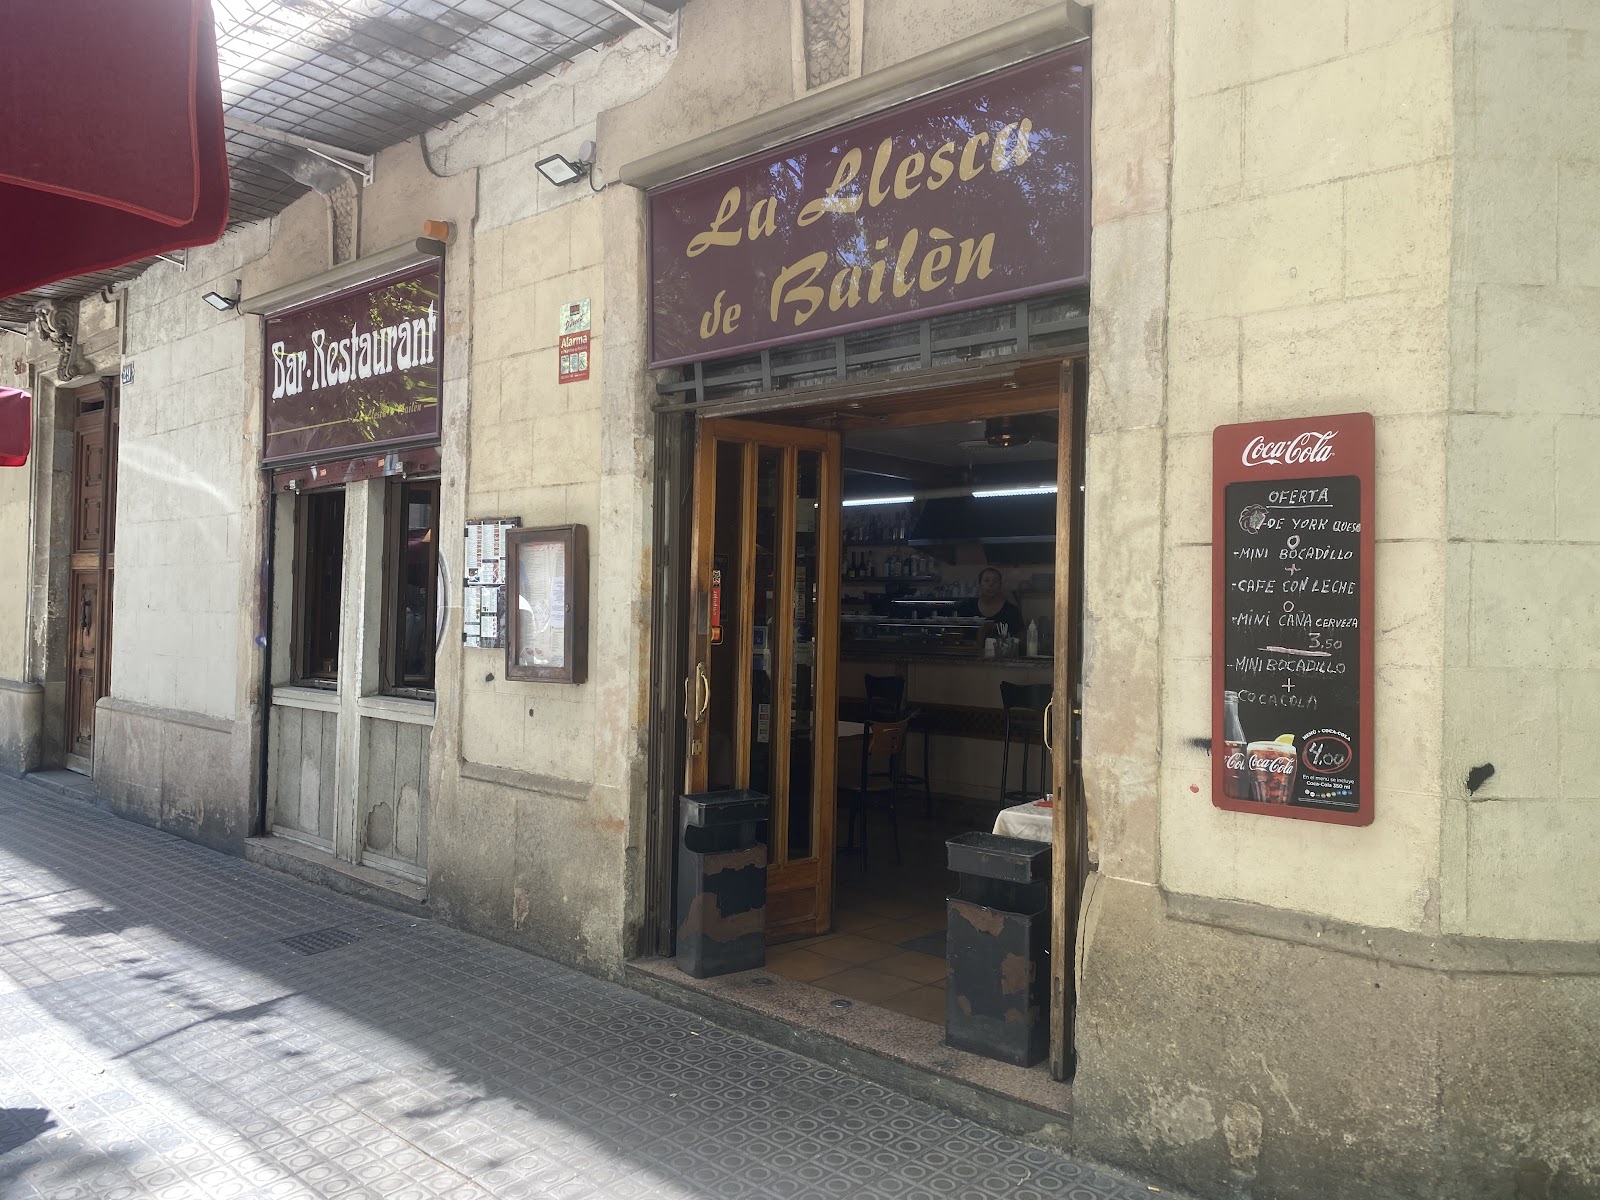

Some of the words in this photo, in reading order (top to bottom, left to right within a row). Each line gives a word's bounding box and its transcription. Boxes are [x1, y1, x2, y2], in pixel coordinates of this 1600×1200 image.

[686, 186, 779, 258] La
[797, 117, 1034, 227] Llesca
[699, 290, 742, 340] de
[770, 228, 996, 326] Bailèn
[561, 334, 588, 349] Alarma
[1241, 430, 1339, 467] Coca-Cola
[1268, 487, 1329, 504] OFERTA
[1292, 518, 1329, 530] YORK
[1332, 520, 1362, 533] QUESO
[1287, 535, 1300, 550] O
[1279, 546, 1353, 560] BOCADILLO
[1282, 577, 1309, 593] CON
[1312, 579, 1356, 595] LECHE
[1278, 611, 1312, 627] CAÑA
[1315, 618, 1359, 628] CERVEZA
[1266, 658, 1346, 674] BOCADILLO
[1321, 728, 1352, 742] COCA-COLA
[1248, 753, 1296, 775] Coca-Cola
[1306, 780, 1332, 788] Coca-Cola
[1336, 777, 1355, 785] incluye
